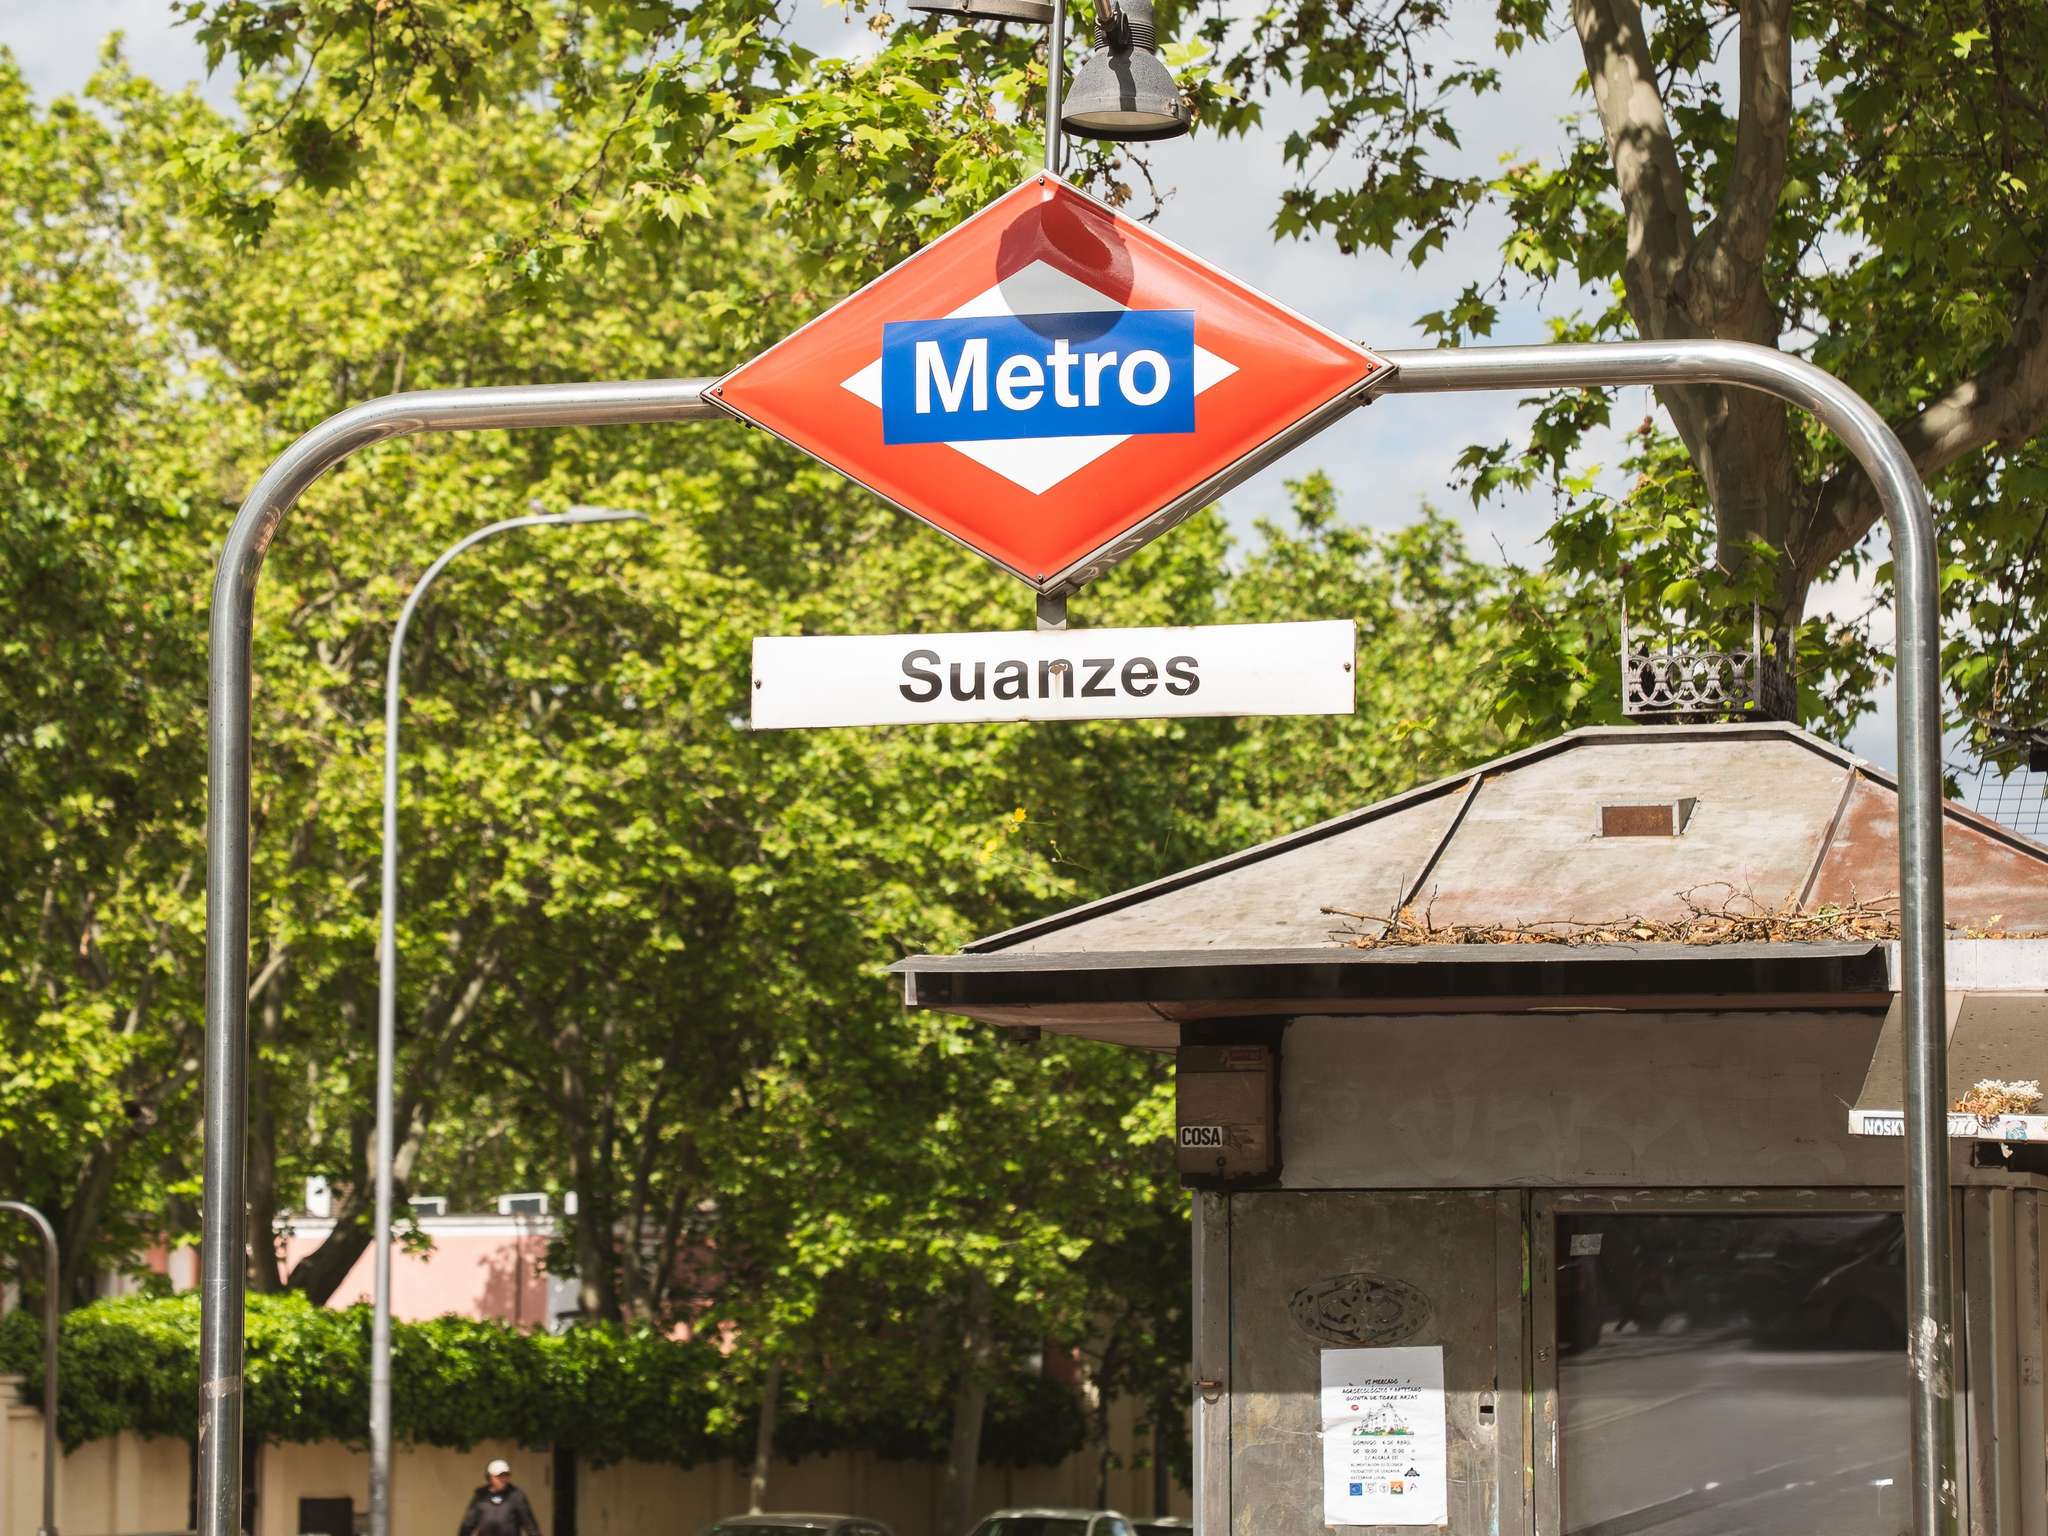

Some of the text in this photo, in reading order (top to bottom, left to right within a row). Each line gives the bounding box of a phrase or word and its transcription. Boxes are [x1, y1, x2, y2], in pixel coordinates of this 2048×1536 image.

[914, 337, 1171, 414] Metro
[899, 648, 1201, 703] Suanzes
[1181, 1127, 1221, 1145] COSA
